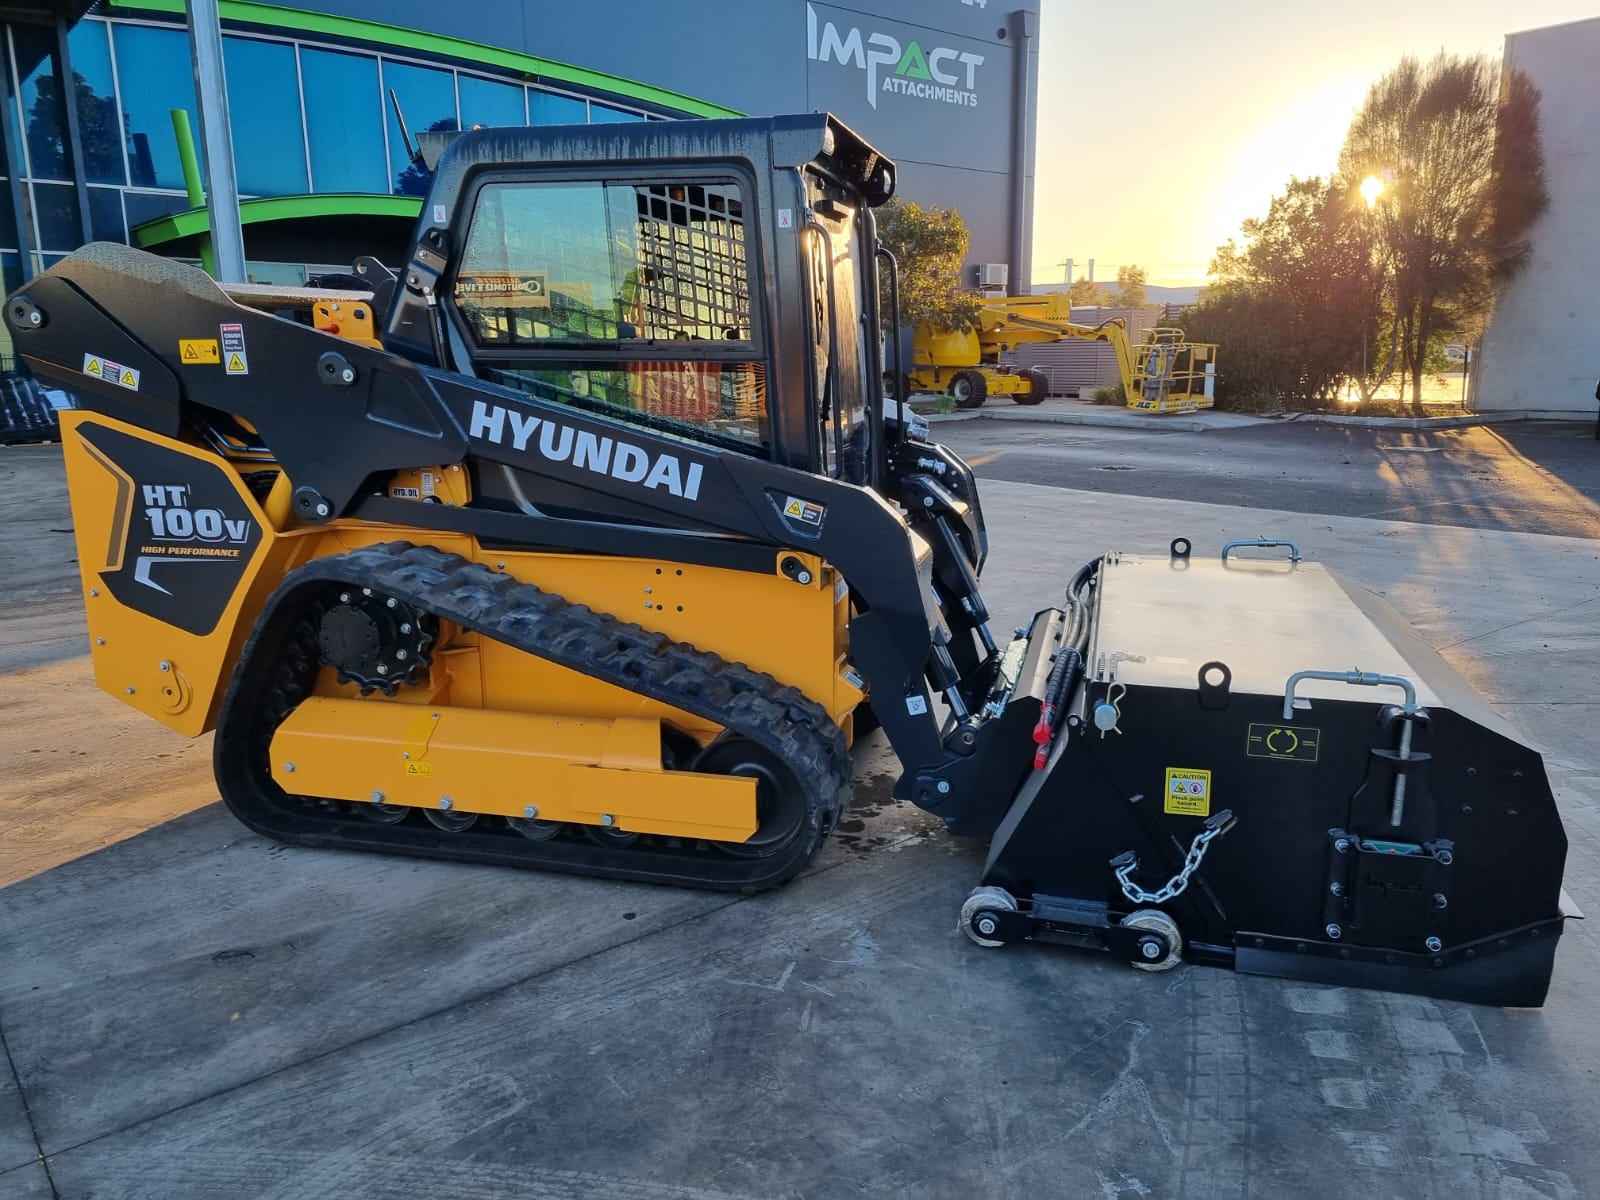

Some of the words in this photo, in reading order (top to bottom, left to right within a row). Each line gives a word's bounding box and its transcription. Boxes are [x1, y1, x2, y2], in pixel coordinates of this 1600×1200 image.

[806, 2, 986, 110] IMPACT
[882, 76, 979, 107] ATTACHMENTS
[469, 400, 704, 501] HYUNDAI
[142, 485, 186, 507] HT
[408, 488, 418, 497] OIL
[141, 546, 166, 555] HIGH
[168, 547, 240, 557] PERFORMANCE
